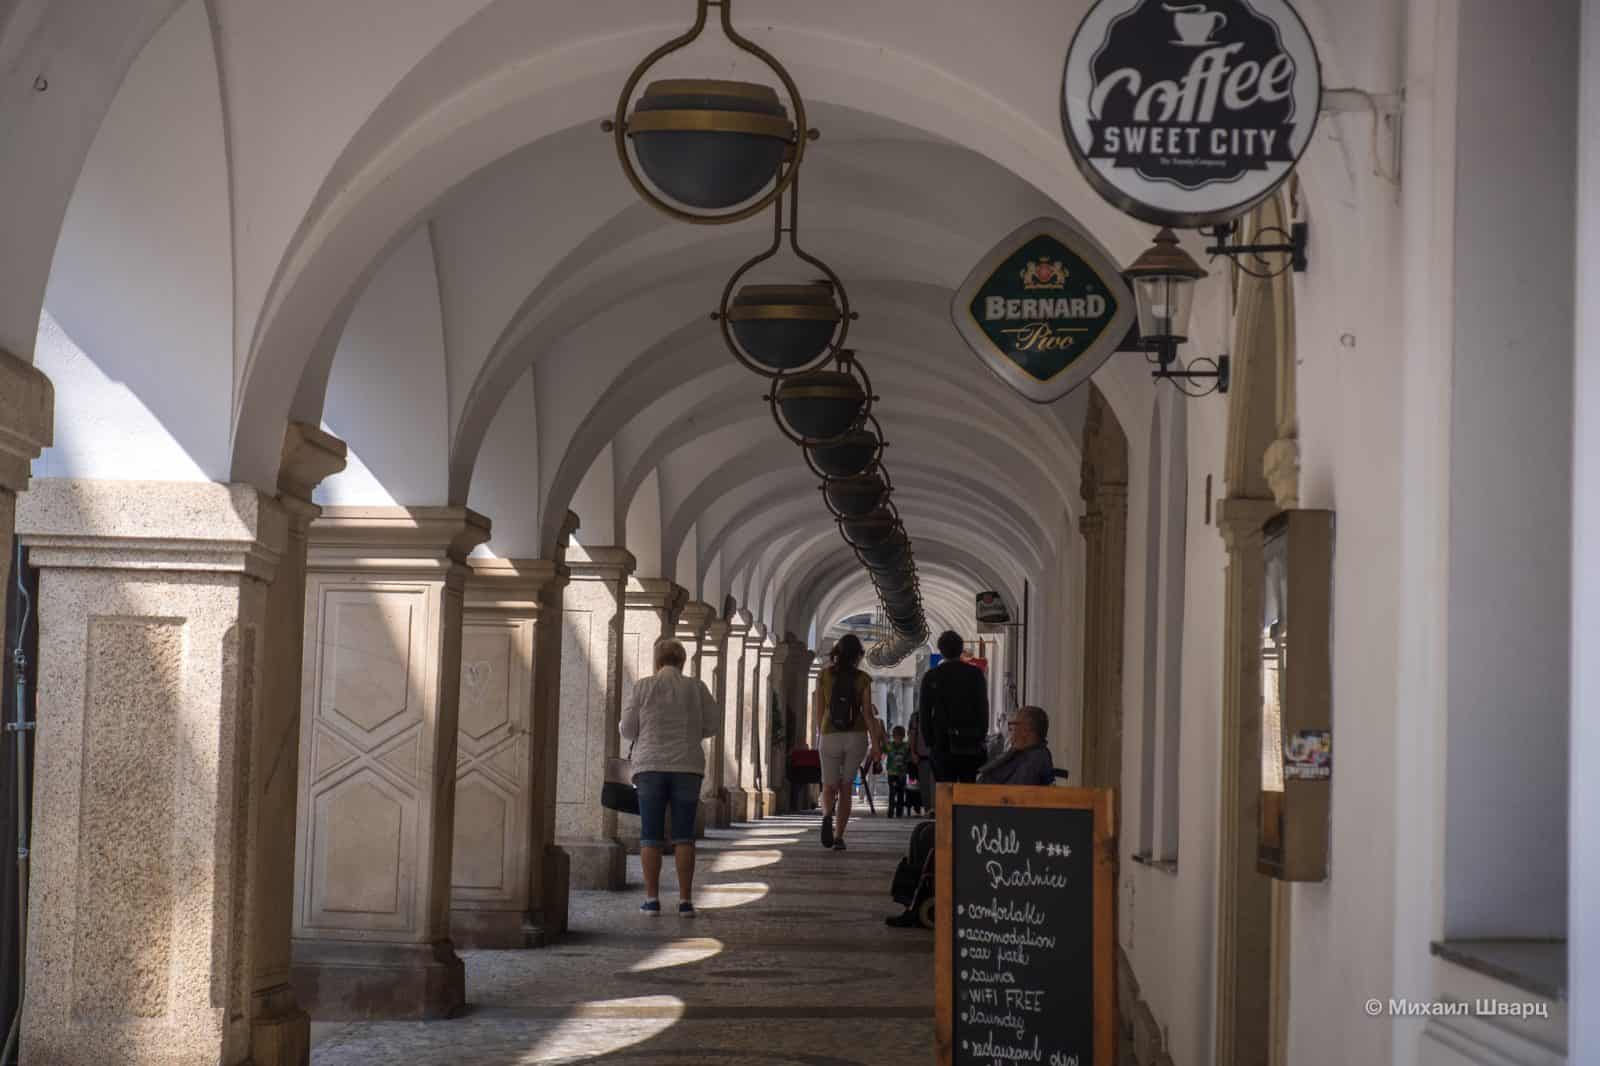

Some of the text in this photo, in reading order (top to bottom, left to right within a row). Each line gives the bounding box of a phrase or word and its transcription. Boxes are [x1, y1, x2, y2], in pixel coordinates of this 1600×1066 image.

[1091, 42, 1292, 122] Coffee
[1104, 126, 1277, 155] SWEET CITY
[985, 294, 1106, 320] BERNARD
[1015, 322, 1073, 351] Pivo
[971, 823, 1020, 855] Hotel
[969, 944, 1029, 970] car park
[969, 967, 1016, 984] sauna
[969, 988, 1045, 1012] WIFI FREE
